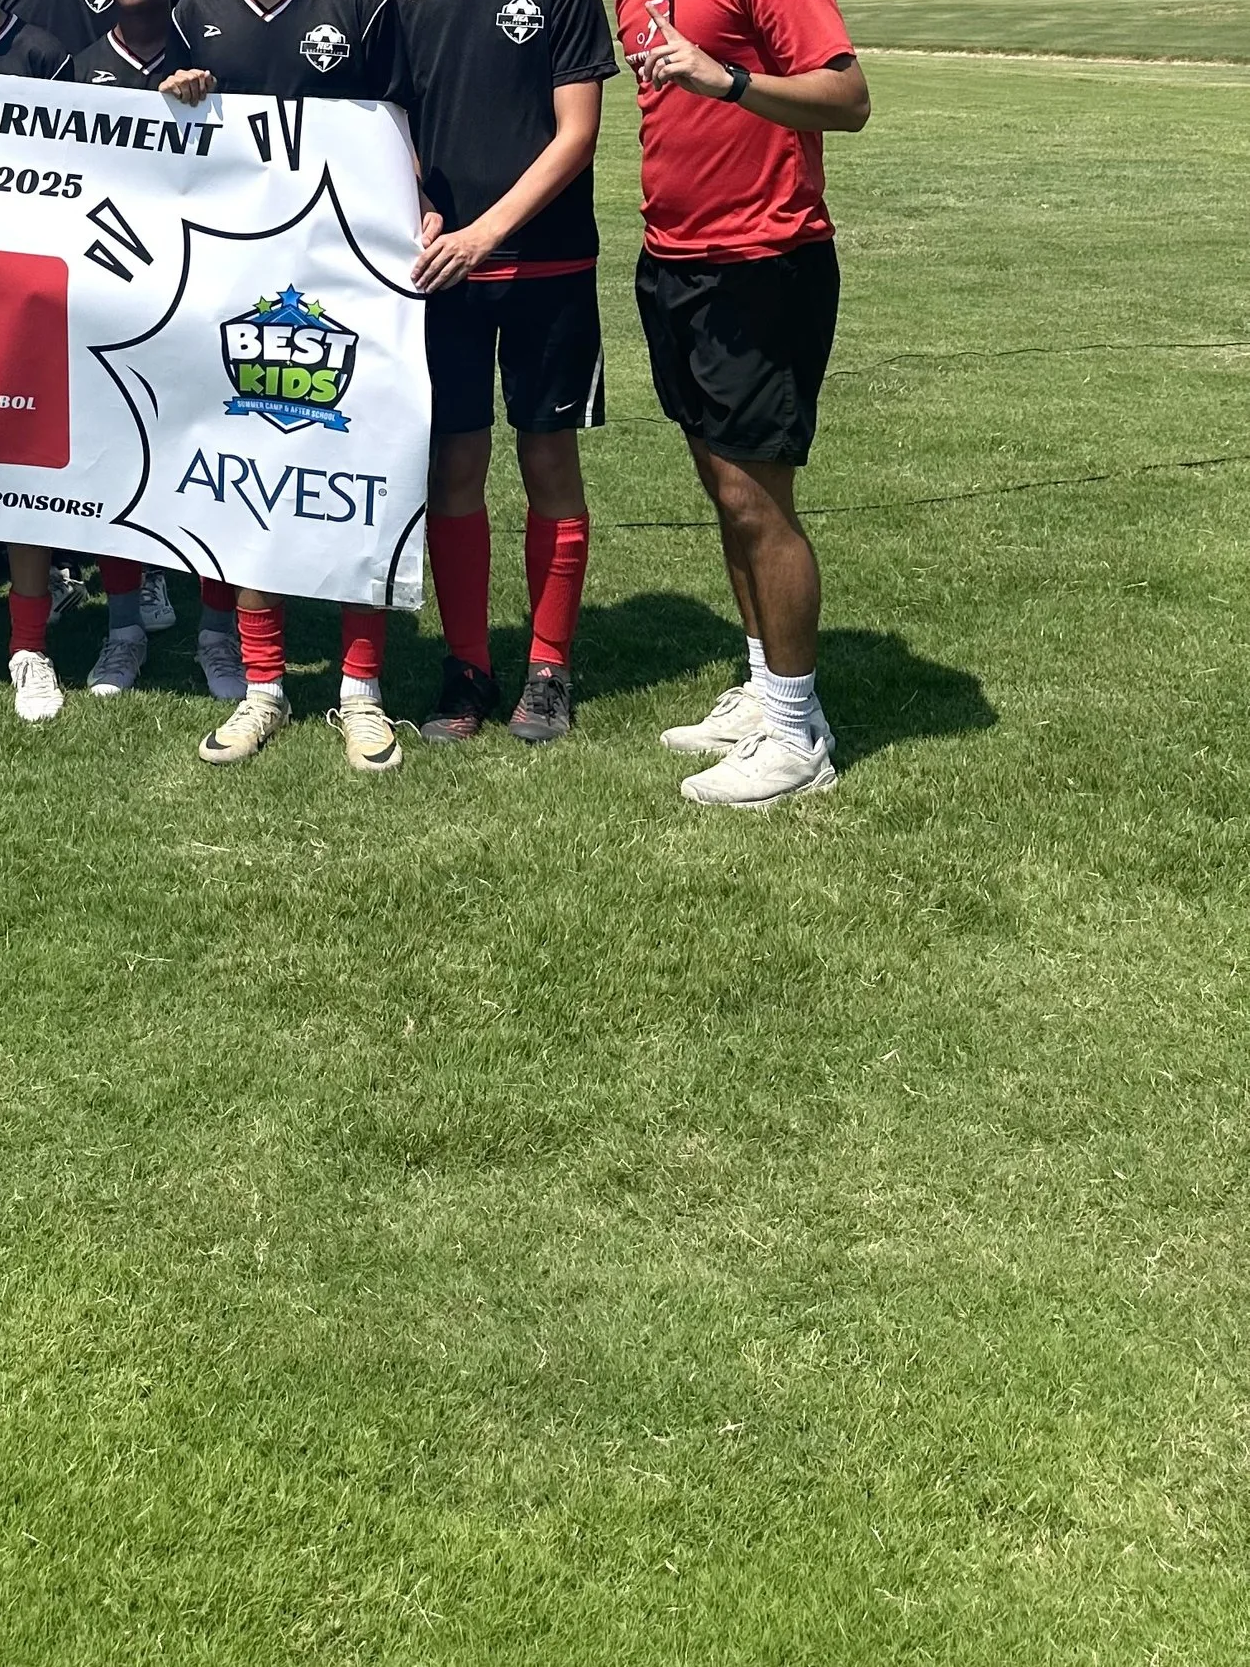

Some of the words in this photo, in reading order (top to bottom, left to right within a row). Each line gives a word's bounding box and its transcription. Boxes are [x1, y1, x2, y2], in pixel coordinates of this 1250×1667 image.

[225, 322, 357, 368] BEST
[238, 363, 338, 403] KIDS
[237, 400, 264, 409] SUMMER
[265, 402, 283, 411] CAMP
[290, 406, 310, 416] AFTER
[311, 410, 336, 421] SCHOOL
